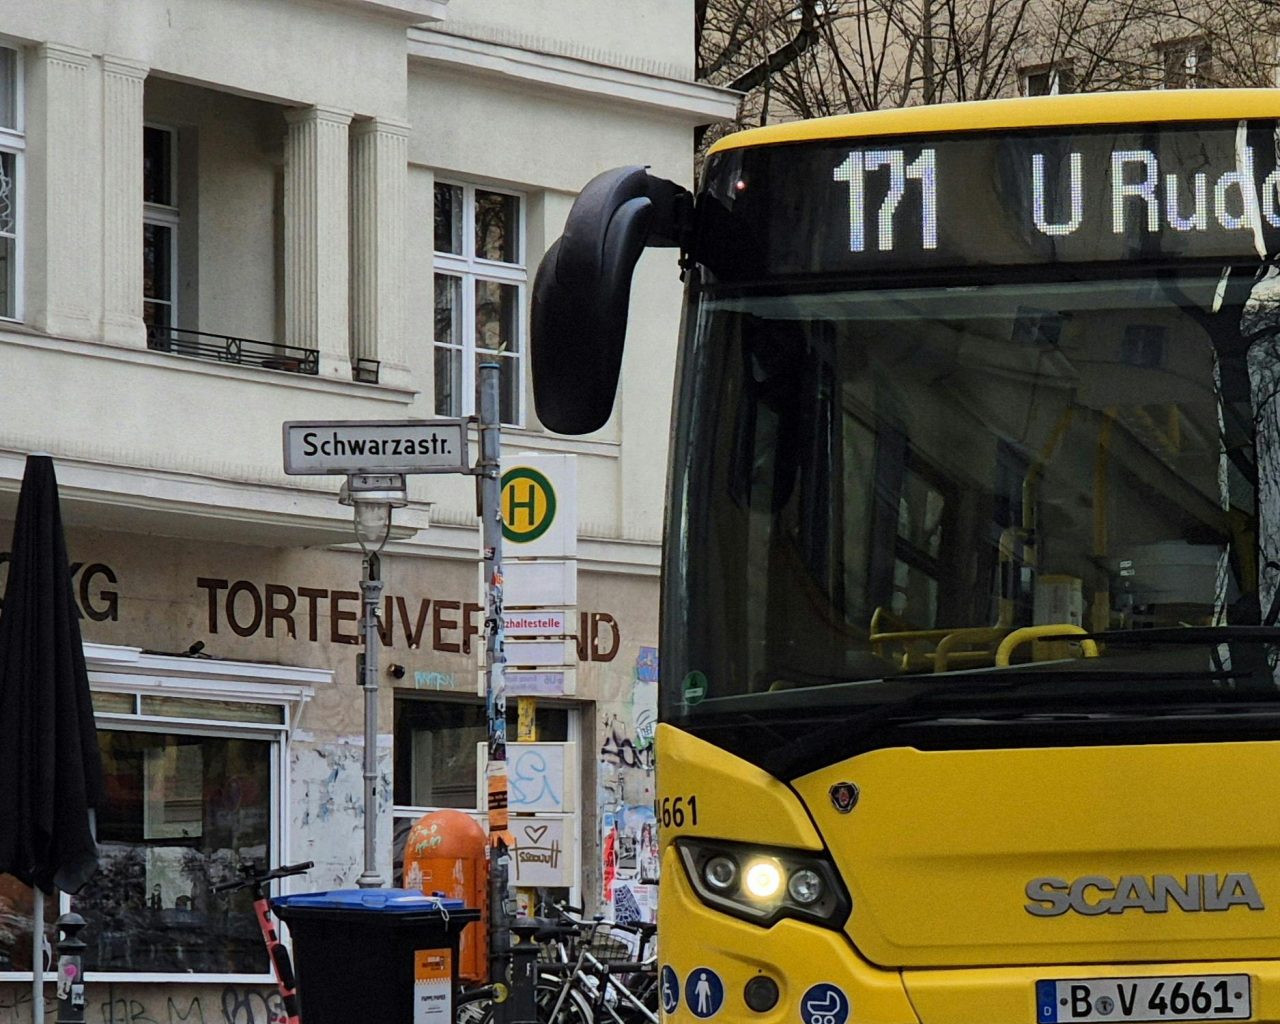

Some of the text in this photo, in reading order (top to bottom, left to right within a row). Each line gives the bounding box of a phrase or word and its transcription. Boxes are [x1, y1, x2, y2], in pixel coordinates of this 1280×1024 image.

[833, 149, 937, 252] 171
[1032, 153, 1082, 236] U
[303, 432, 451, 457] Schwarzastr.
[509, 484, 534, 526] H
[502, 617, 560, 628] zhaltestelle
[1024, 873, 1265, 917] SCANIA
[1071, 985, 1092, 1018] B
[1117, 983, 1138, 1016] V
[1148, 980, 1234, 1015] 4661
